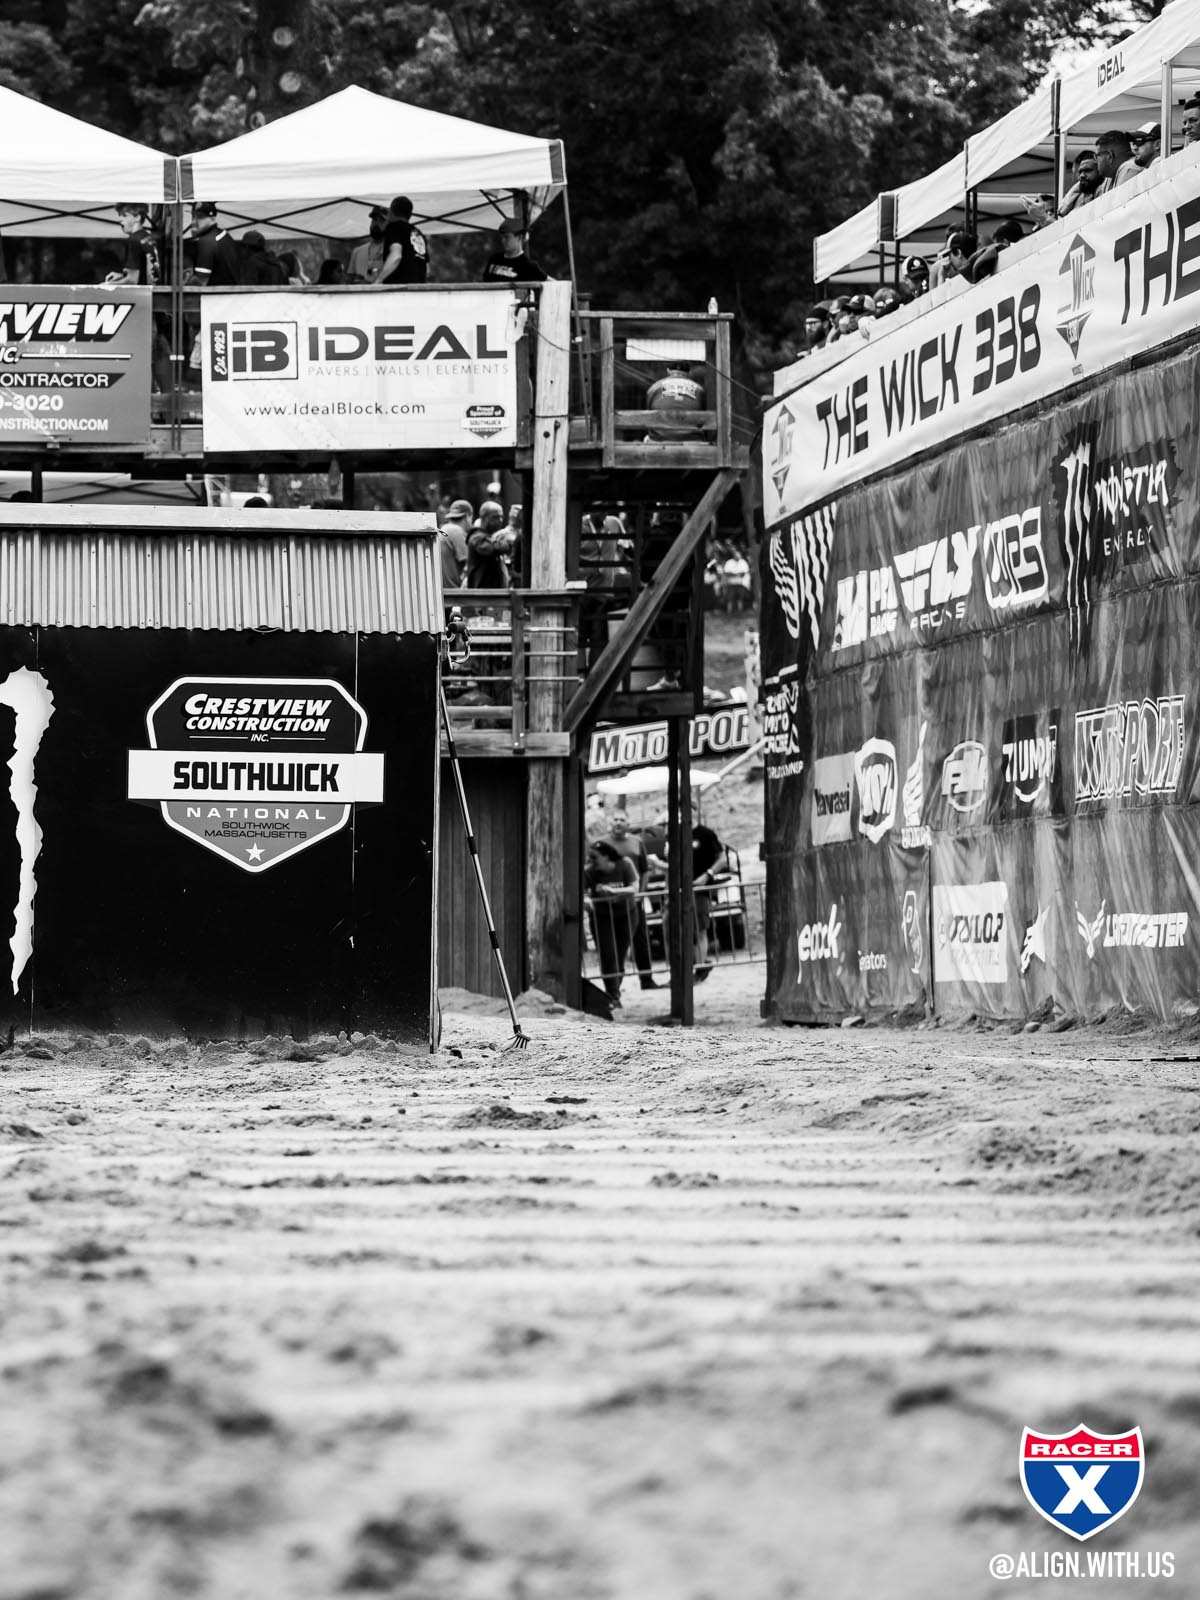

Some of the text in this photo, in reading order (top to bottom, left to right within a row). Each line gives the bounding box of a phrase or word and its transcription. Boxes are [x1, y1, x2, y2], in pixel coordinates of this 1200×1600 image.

[1097, 51, 1125, 88] IDEAL
[1114, 196, 1200, 325] THE
[213, 329, 226, 355] 1923
[308, 324, 509, 362] IDEAL
[308, 362, 511, 377] PAVERS WALLS ELEMENTS
[816, 374, 869, 471] THE
[879, 323, 963, 438] WICK
[972, 283, 1042, 396] 338
[243, 401, 427, 417] www.IdealBlock.com
[184, 693, 332, 716] CRESTVIEW
[185, 716, 331, 732] CONSTRUCTION
[250, 733, 269, 743] INC.
[173, 761, 340, 792] SOUTHWICK
[186, 807, 326, 820] NATIONAL
[204, 830, 308, 840] MASSACHUSETTS
[222, 822, 290, 831] SOUTHWICK
